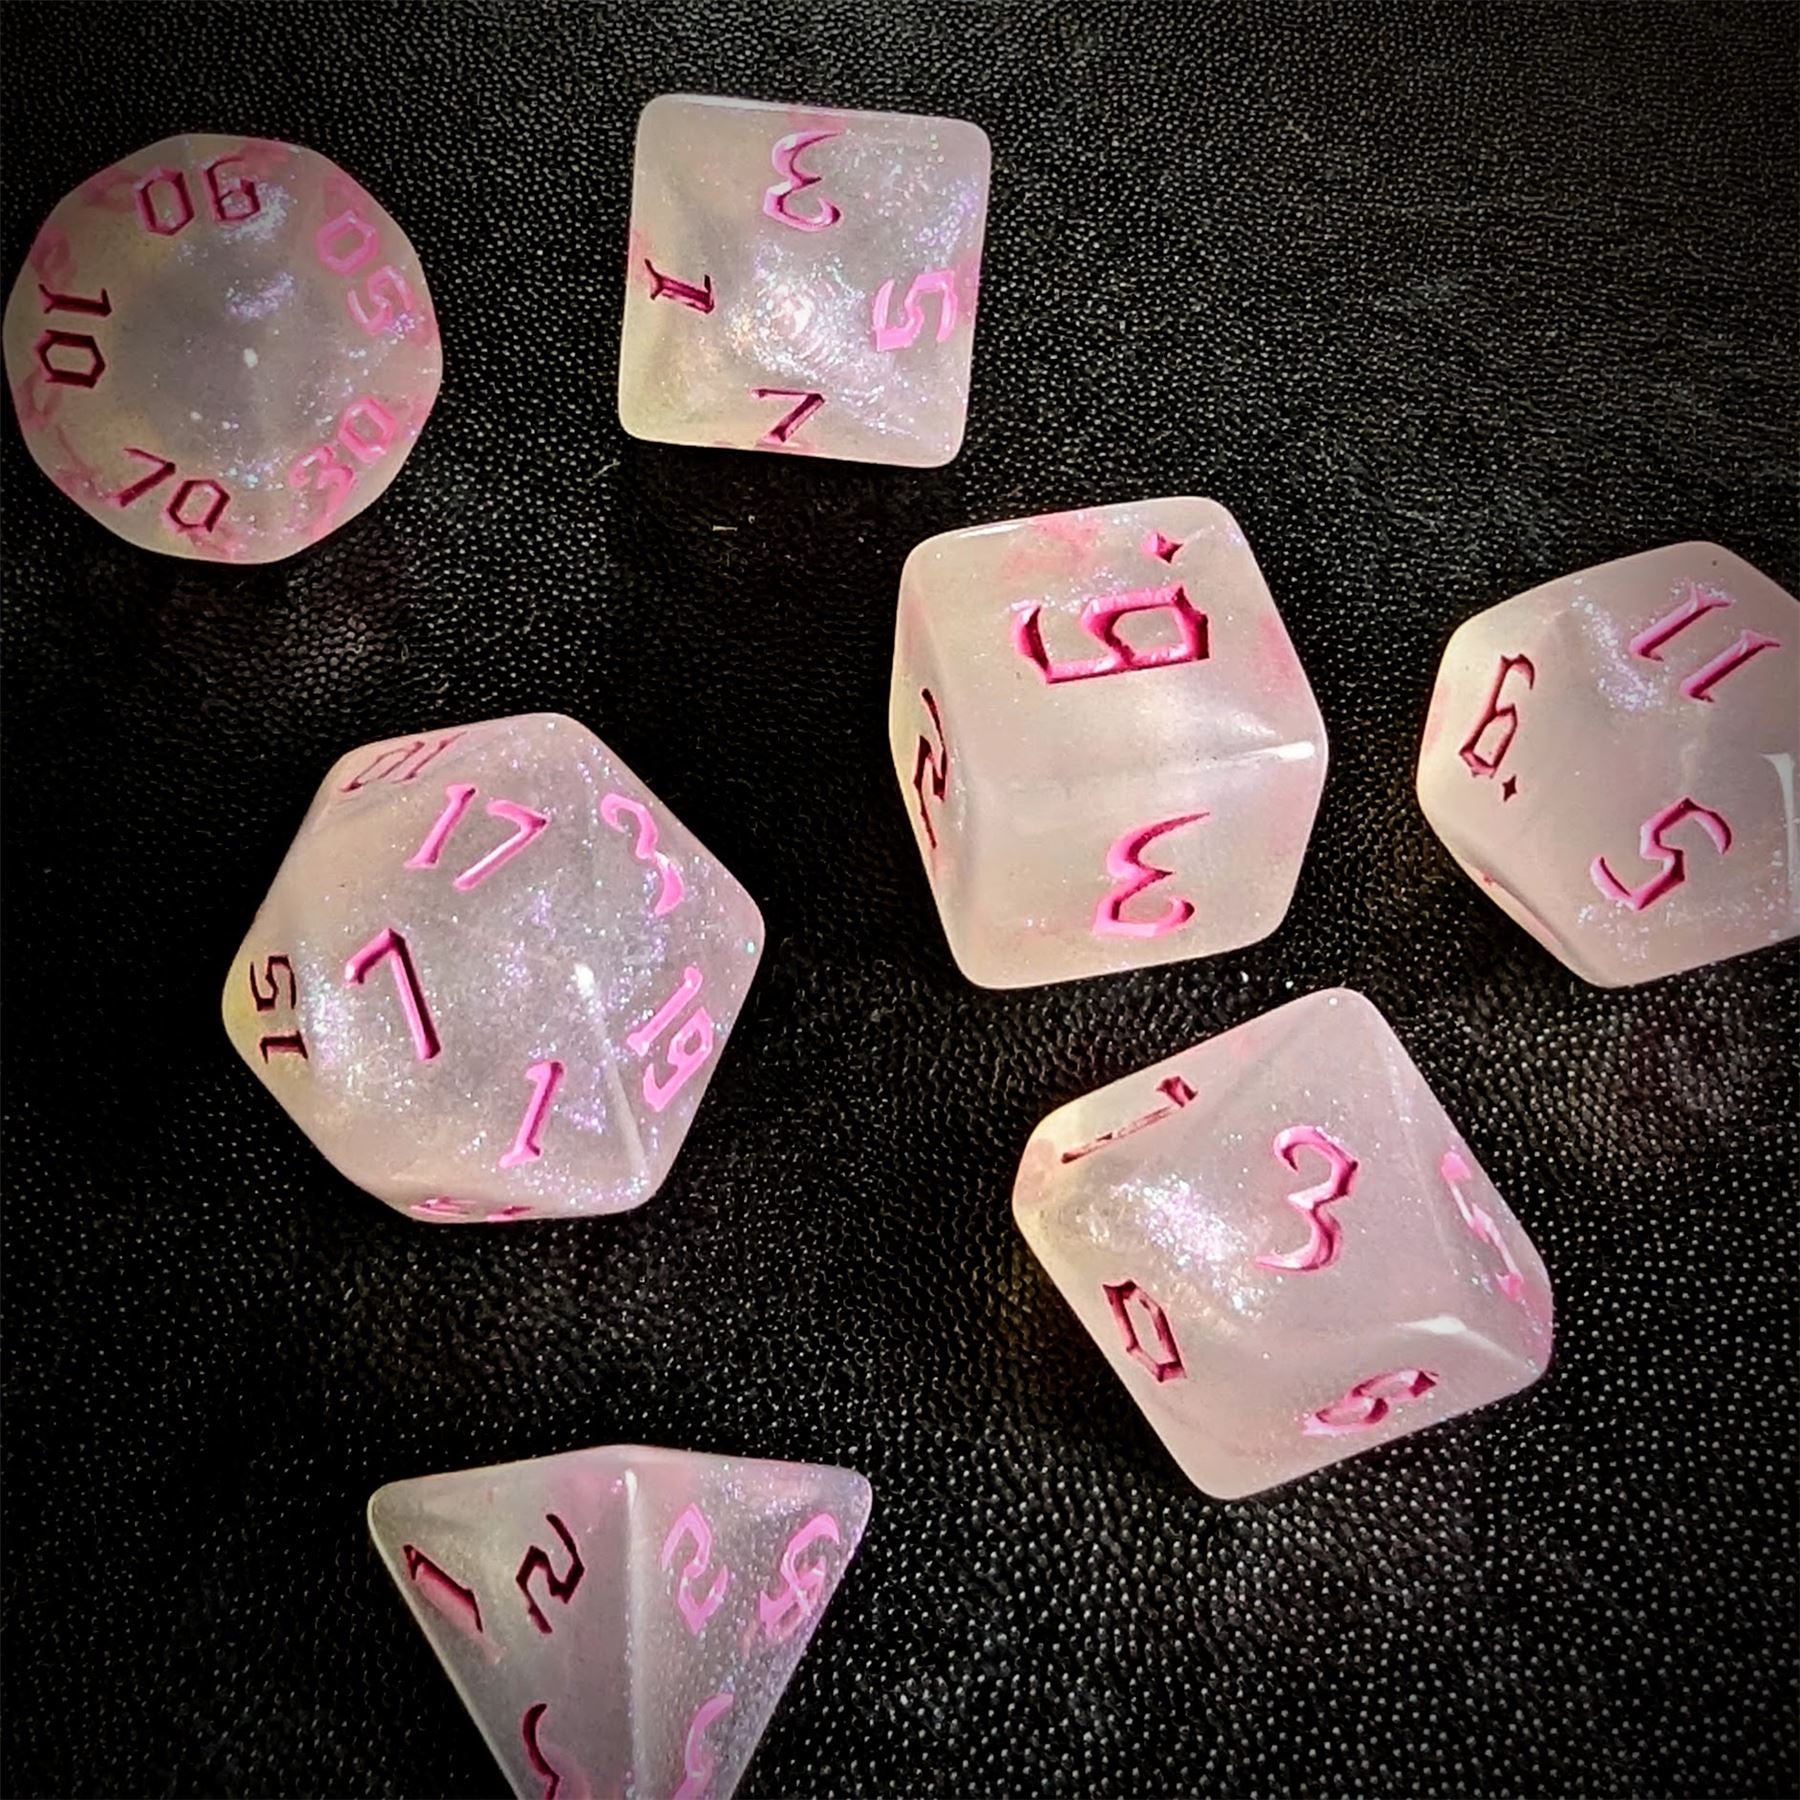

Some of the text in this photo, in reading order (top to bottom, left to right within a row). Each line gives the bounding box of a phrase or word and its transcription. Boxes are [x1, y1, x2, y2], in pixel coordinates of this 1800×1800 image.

[136, 156, 261, 236] 90
[763, 130, 842, 233] 3
[316, 209, 416, 336] 50
[644, 258, 715, 315] 1
[871, 269, 958, 352] 5
[38, 283, 112, 388] 10
[752, 388, 826, 446] 7
[113, 448, 231, 533] 70
[1629, 582, 1781, 703] 11
[338, 731, 468, 793] 10
[403, 783, 549, 891] 17
[600, 793, 685, 916] 3
[1092, 811, 1211, 938] 3
[1590, 797, 1732, 911] 5
[249, 954, 308, 1064] 15
[344, 928, 442, 1061] 7
[626, 966, 714, 1112] 19
[499, 1061, 566, 1170] 1
[1254, 1124, 1359, 1272] 3
[1102, 1278, 1187, 1383] 0
[403, 1544, 484, 1637] 1
[514, 1513, 586, 1635] 2
